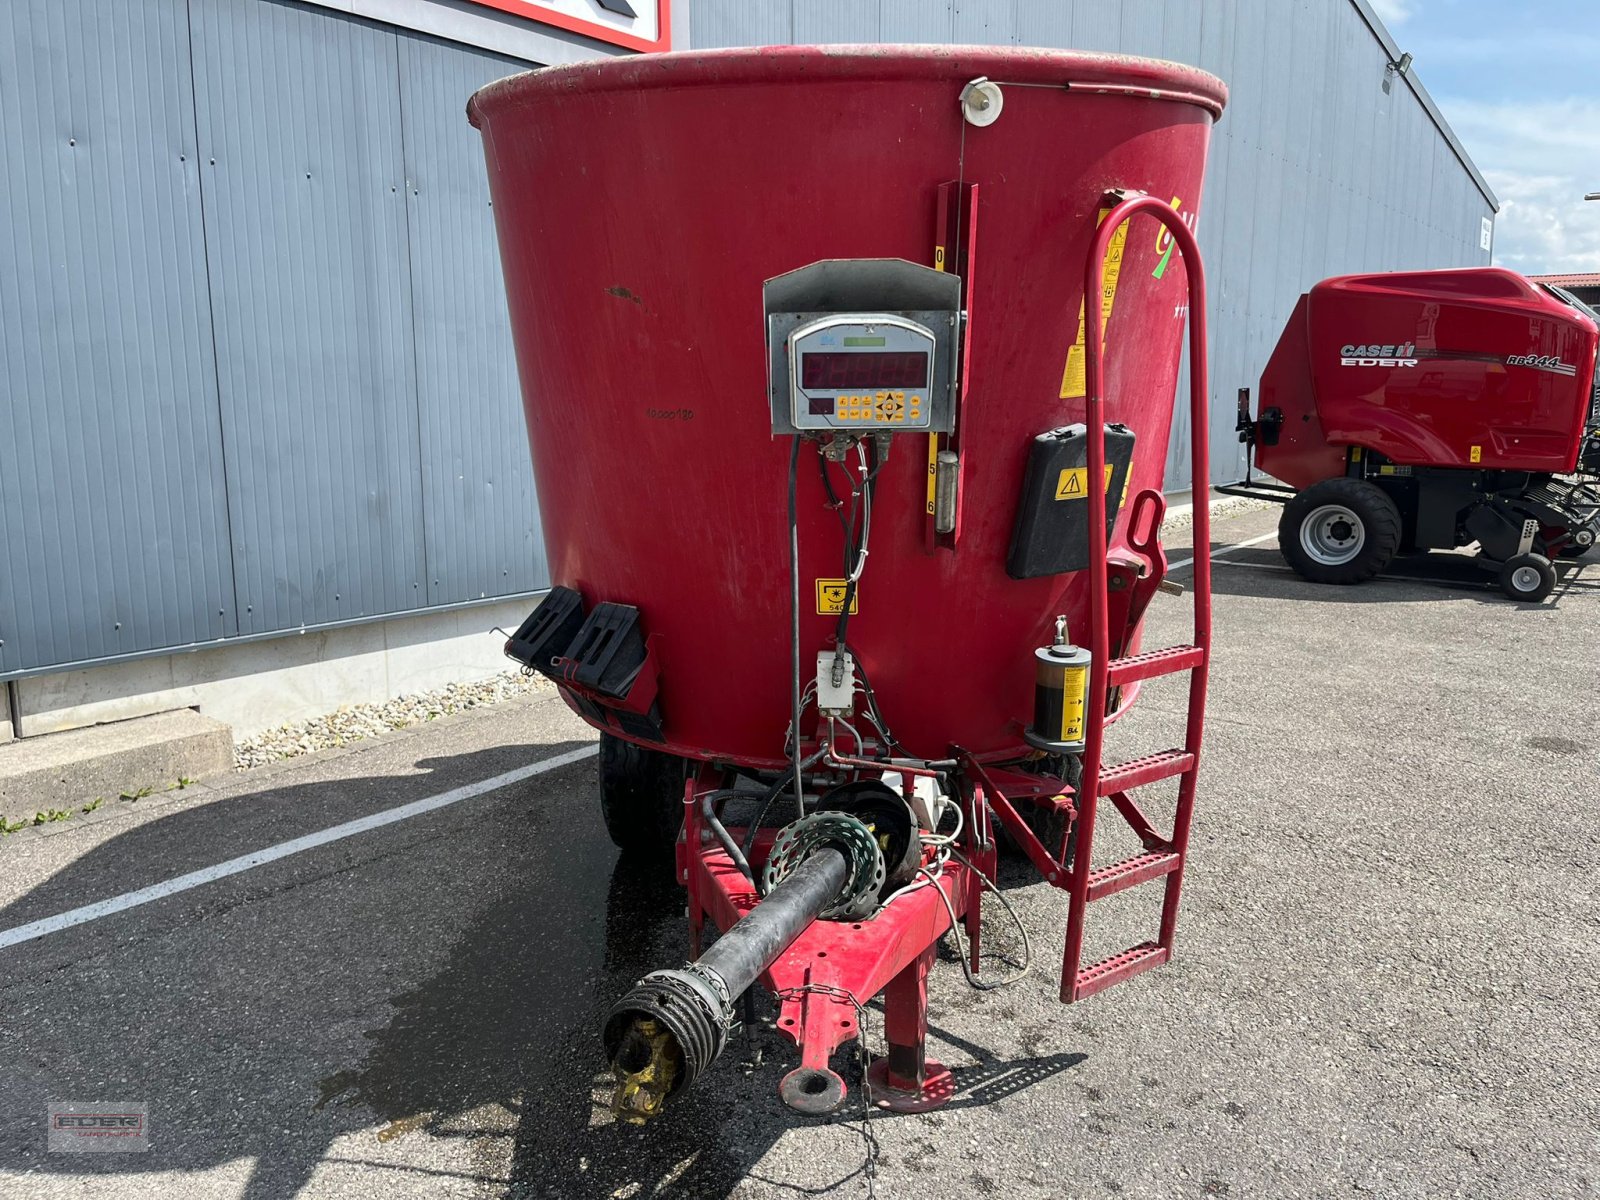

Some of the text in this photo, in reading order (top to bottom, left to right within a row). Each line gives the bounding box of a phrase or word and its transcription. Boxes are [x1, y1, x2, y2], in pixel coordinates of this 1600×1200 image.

[936, 249, 943, 262] 0
[1340, 344, 1396, 357] CASE
[1340, 357, 1418, 367] EDER
[1506, 354, 1561, 367] RB344
[929, 463, 935, 475] 5
[927, 501, 934, 512] 6
